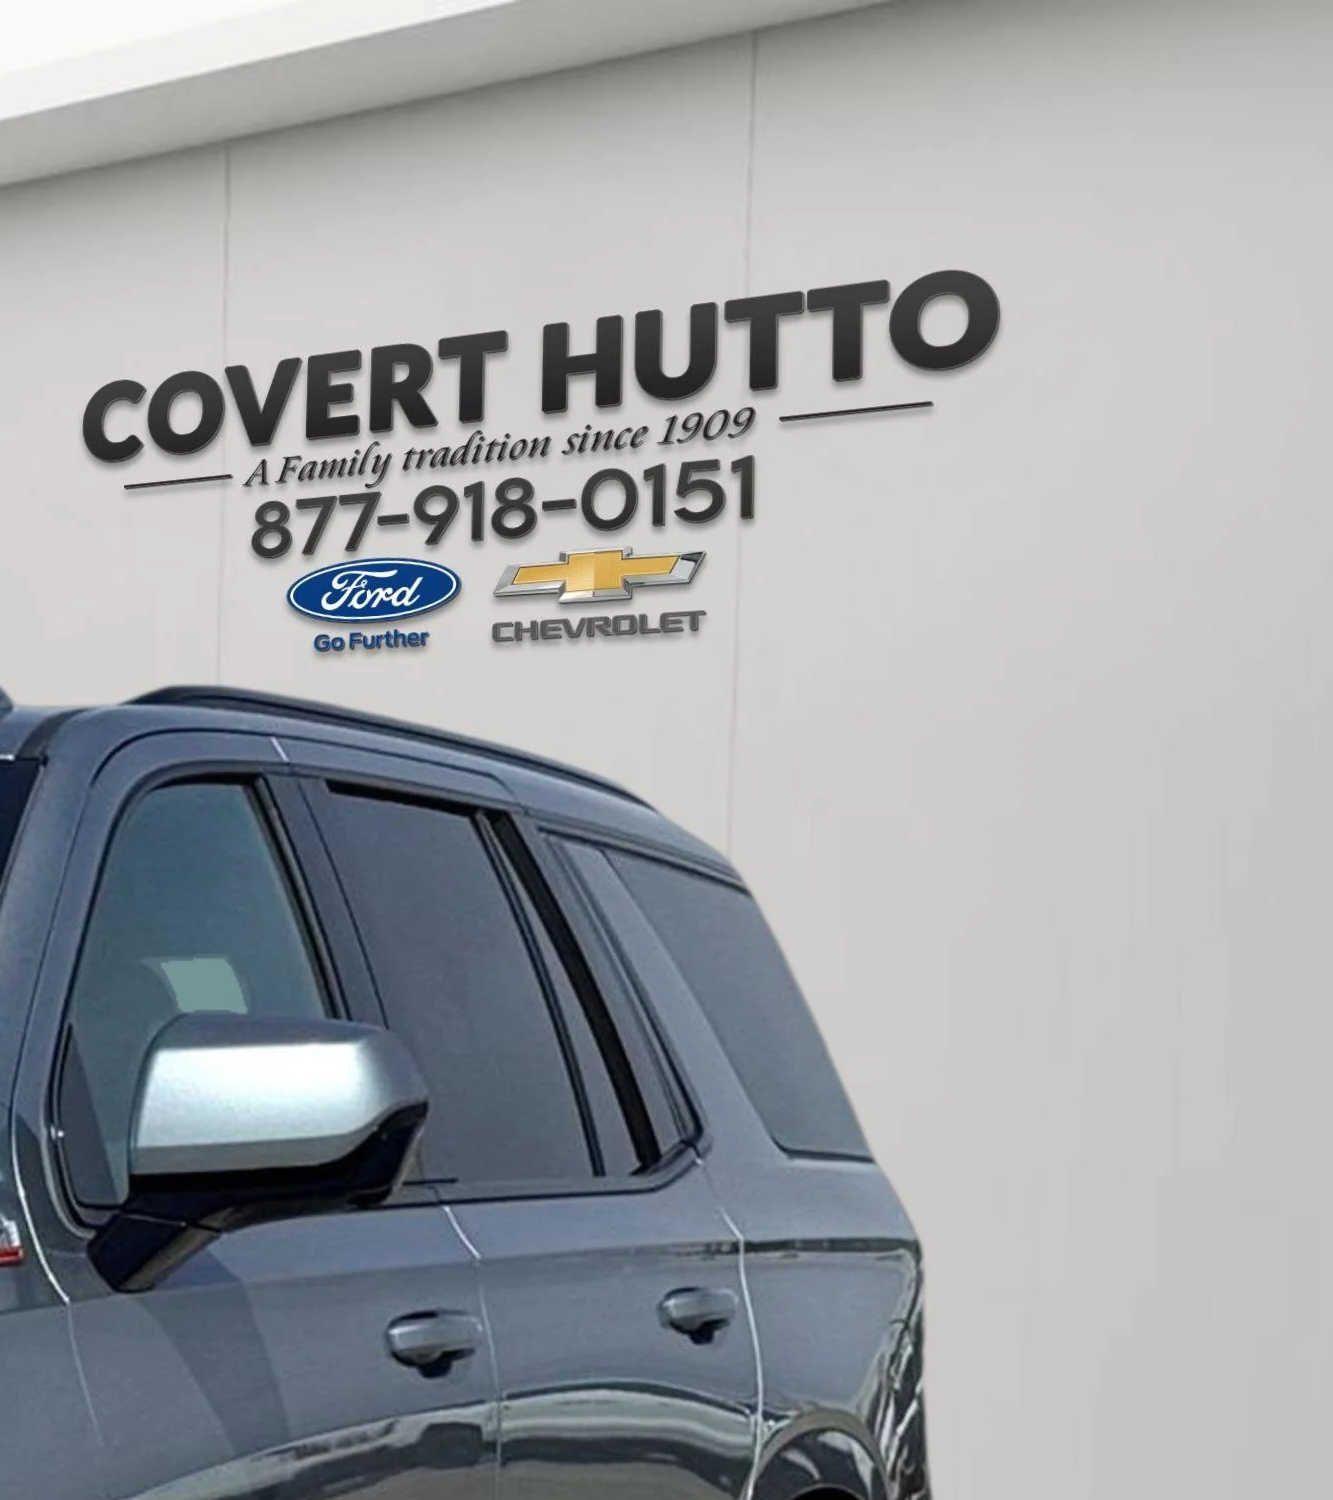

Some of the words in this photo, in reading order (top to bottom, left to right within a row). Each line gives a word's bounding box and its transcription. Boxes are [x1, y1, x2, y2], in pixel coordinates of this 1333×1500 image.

[82, 330, 509, 464] COVERT
[541, 269, 1001, 416] HUTTO
[242, 458, 270, 488] A
[275, 440, 393, 489] Family
[401, 429, 553, 472] tradition
[561, 423, 650, 457] since
[656, 406, 757, 446] 1909
[251, 454, 755, 560] 877-918-0151
[321, 569, 423, 611] Ford
[313, 634, 346, 654] Go
[348, 628, 431, 651] Further
[491, 609, 708, 643] CHEVROLET
